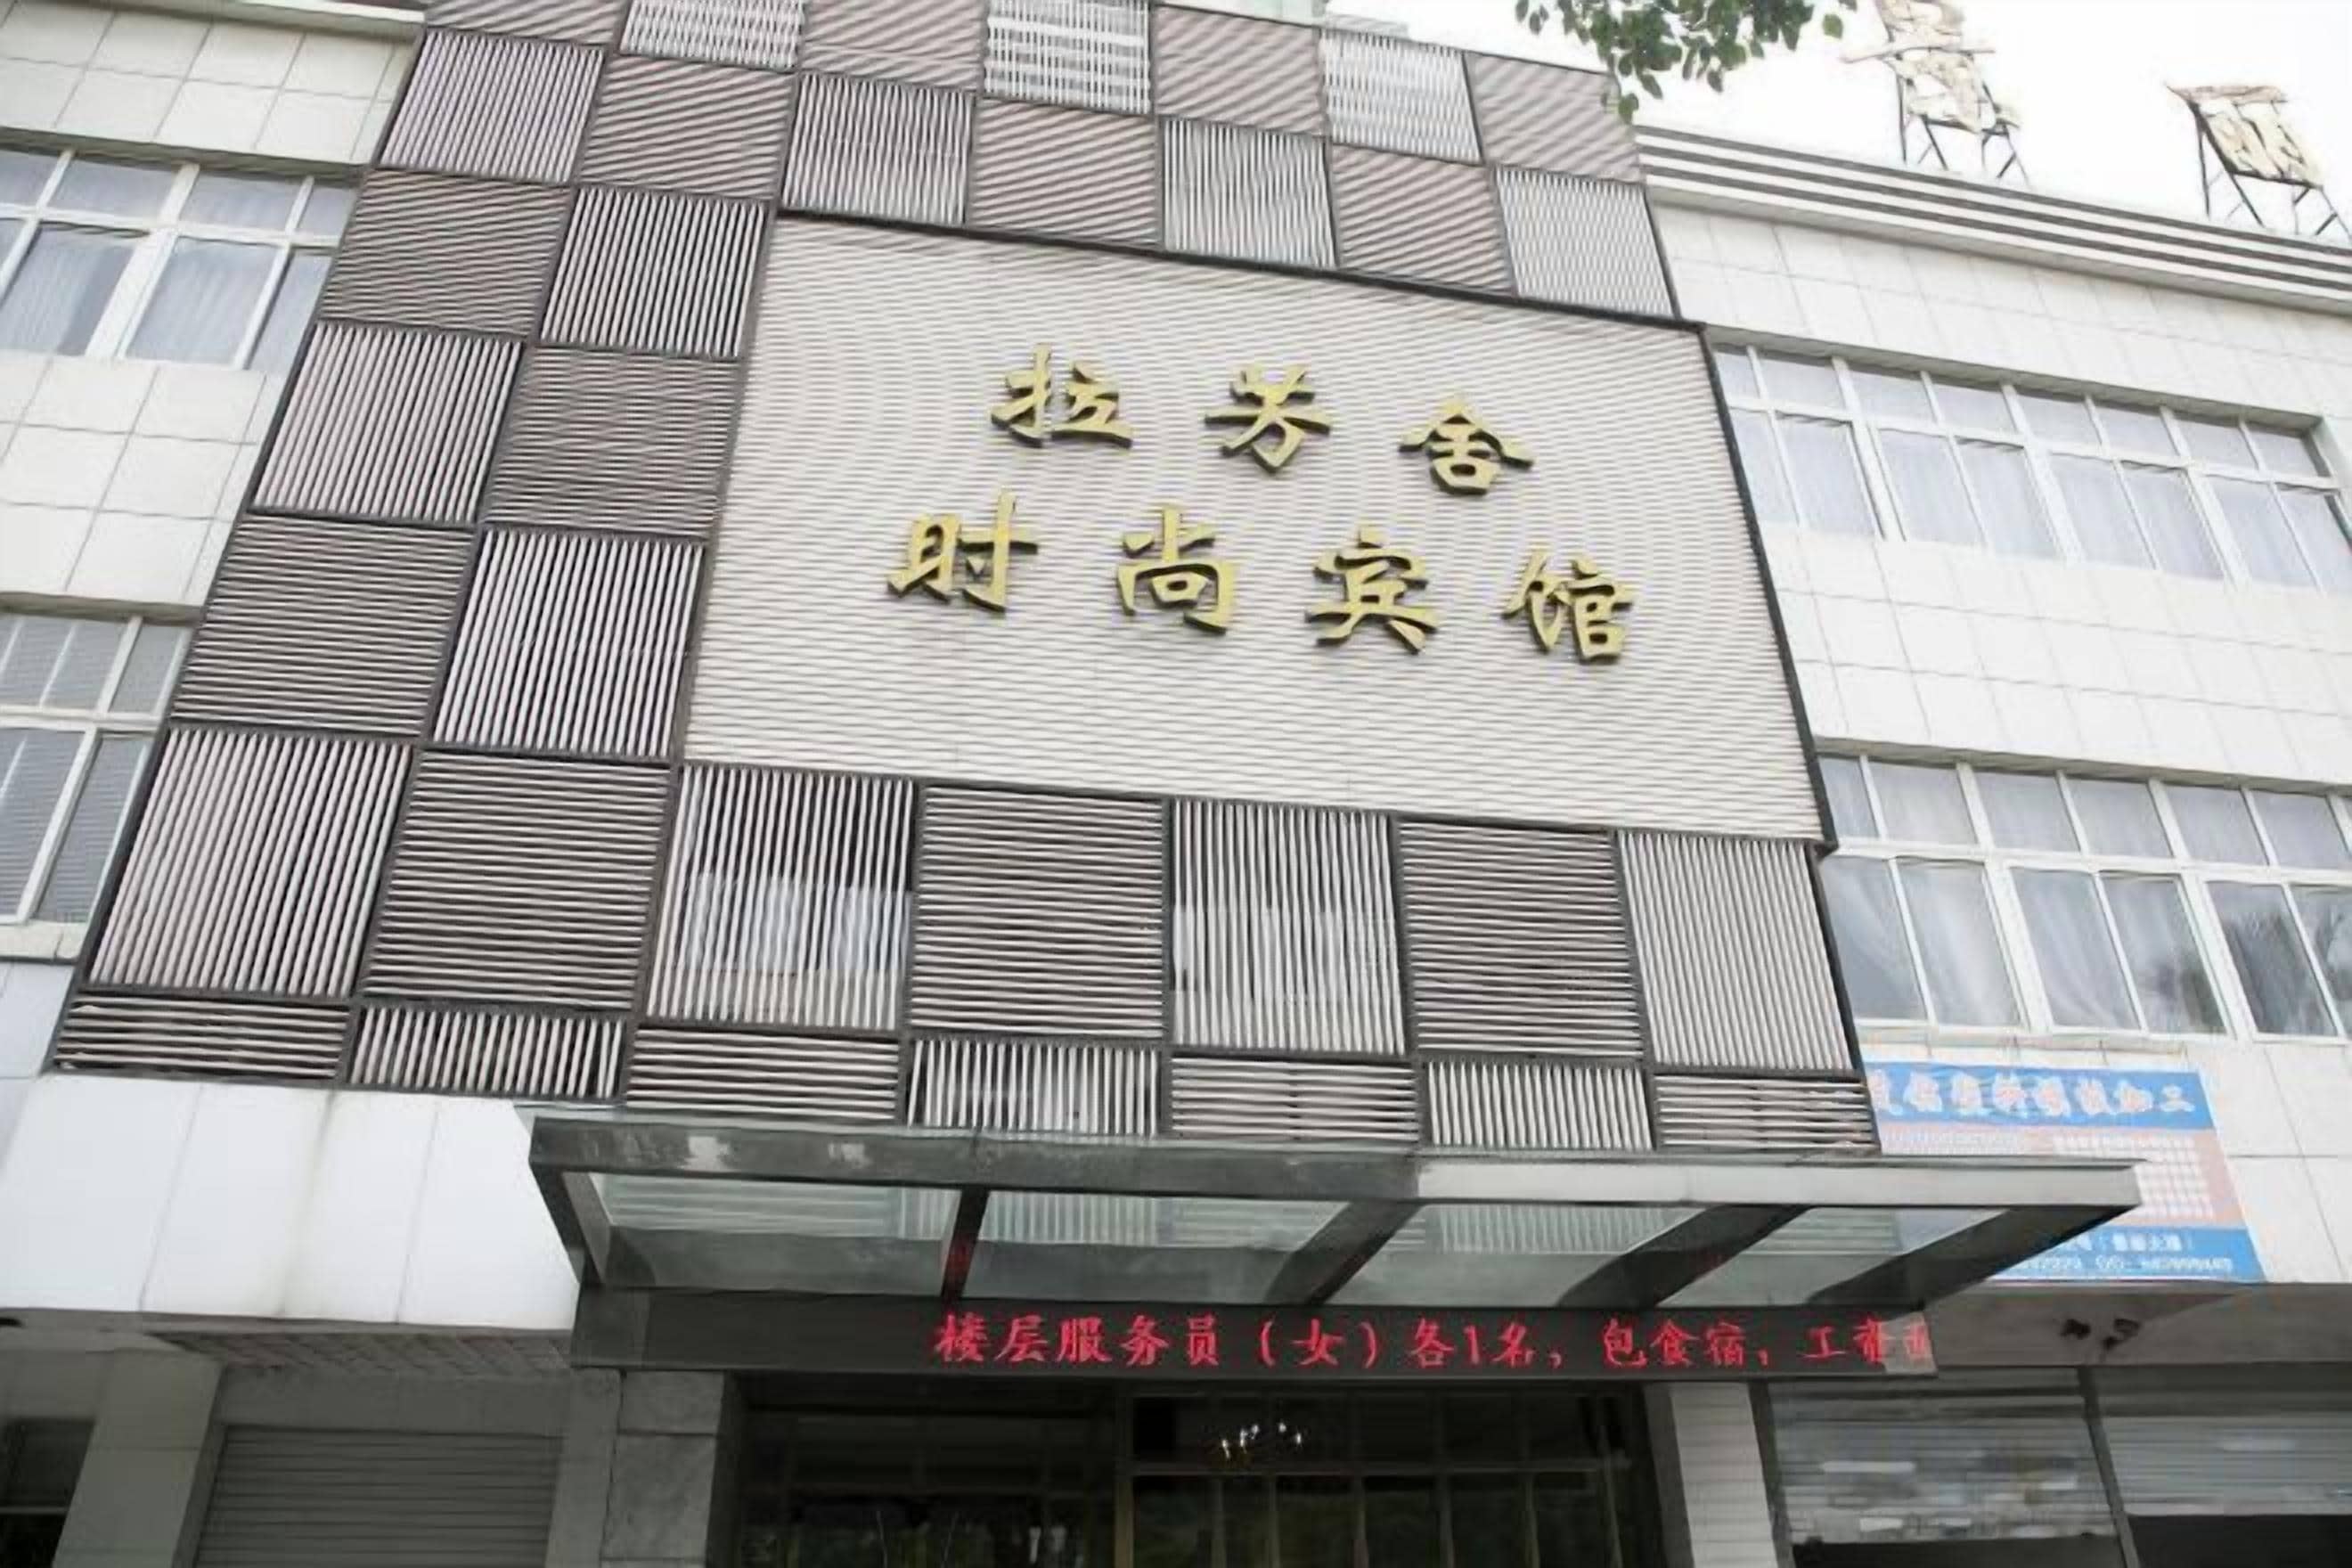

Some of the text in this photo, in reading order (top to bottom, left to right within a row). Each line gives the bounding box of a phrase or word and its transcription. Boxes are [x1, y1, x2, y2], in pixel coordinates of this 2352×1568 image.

[991, 344, 1534, 495] 拉芳舍
[887, 489, 1637, 664] 时尚宾馆
